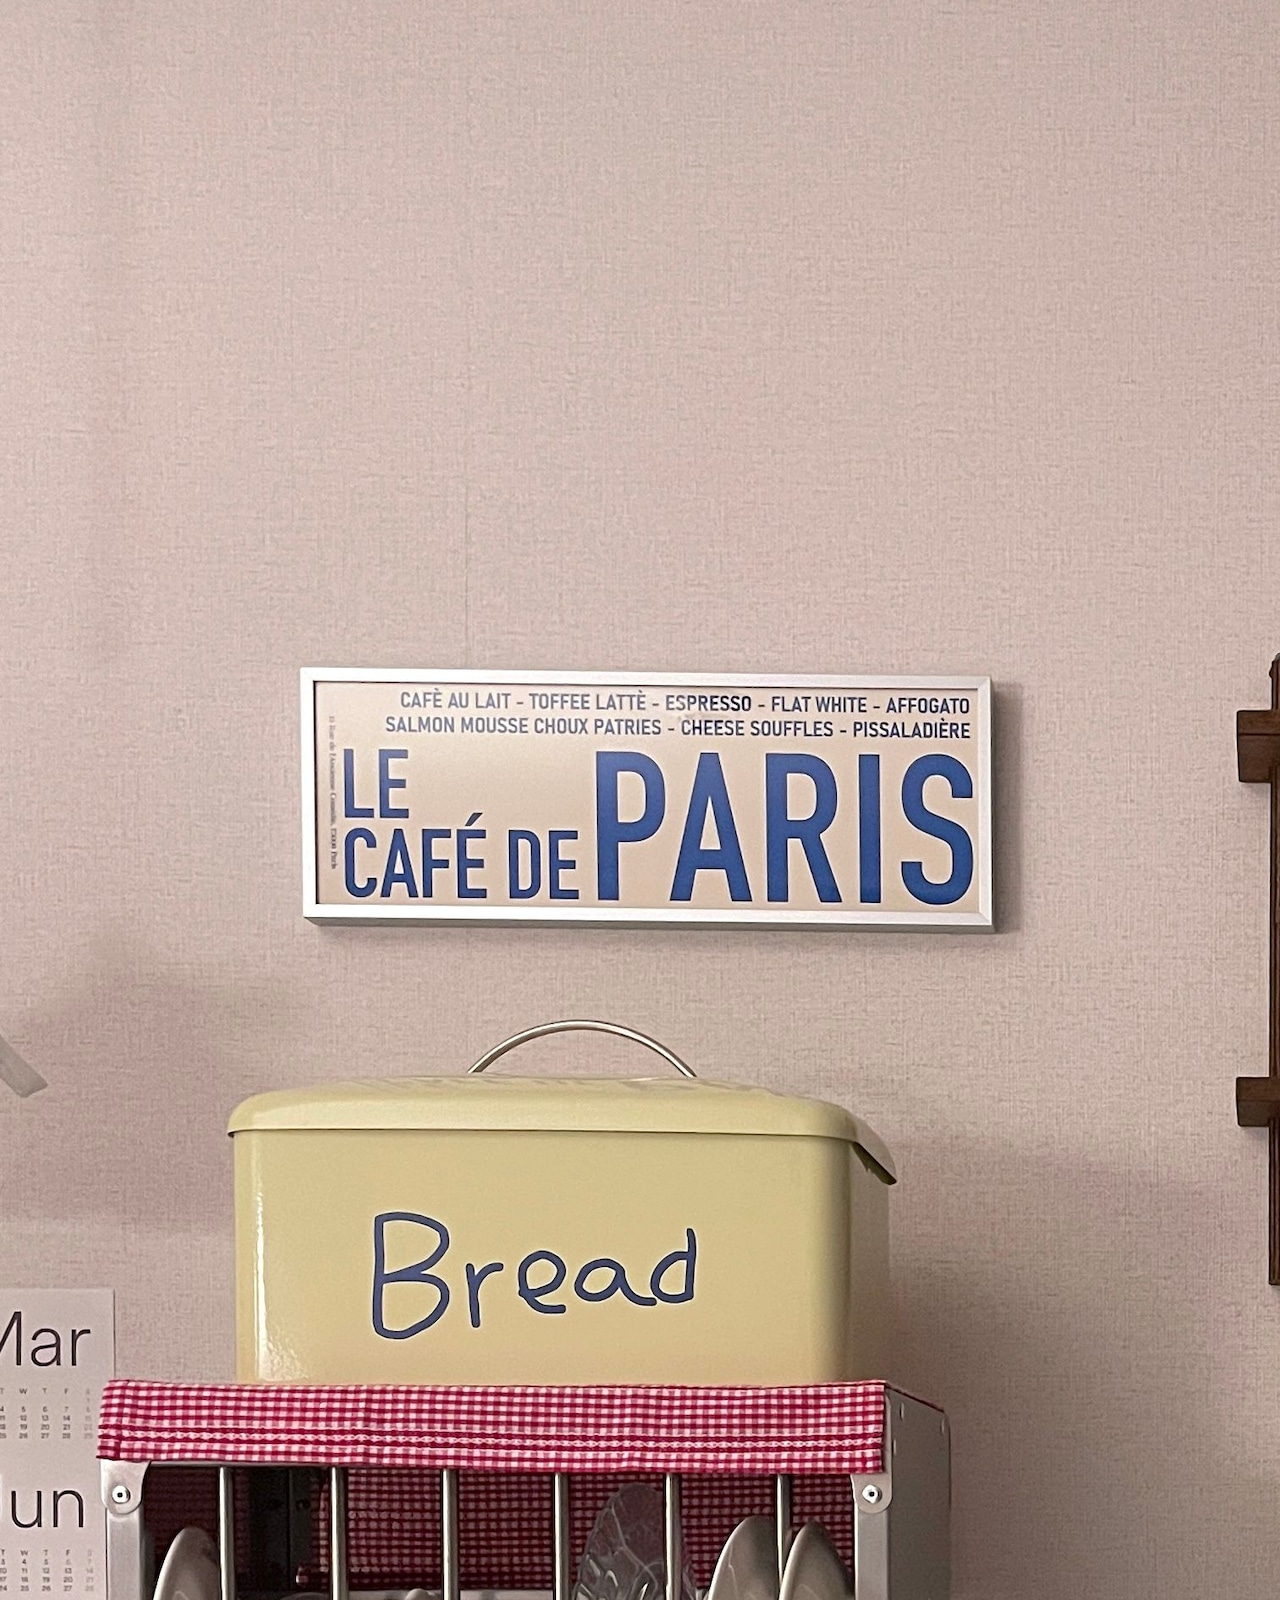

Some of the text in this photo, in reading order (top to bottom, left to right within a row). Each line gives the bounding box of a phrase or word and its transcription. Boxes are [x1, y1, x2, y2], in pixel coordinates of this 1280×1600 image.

[385, 716, 454, 733] SALMON
[460, 716, 528, 734] MOUSSE
[534, 718, 588, 735] CHOUX
[594, 718, 661, 736] PATRIES
[681, 720, 745, 736] CHEESE
[750, 720, 833, 738] SOUFFLES
[853, 717, 971, 739] PISSALADIÈRE
[400, 688, 442, 709] CAFÈ
[447, 691, 469, 709] AU
[475, 692, 511, 710] LAIT
[529, 693, 590, 710] TOFFEE
[596, 690, 646, 711] LATTÈ
[665, 694, 751, 712] ESPRESSO
[771, 696, 811, 713] FLAT
[816, 697, 867, 713] WHITE
[886, 698, 969, 714] AFFOGATO
[343, 748, 409, 819] LE
[343, 751, 974, 906] CAFÉ DE PARIS
[372, 1211, 697, 1340] Bread
